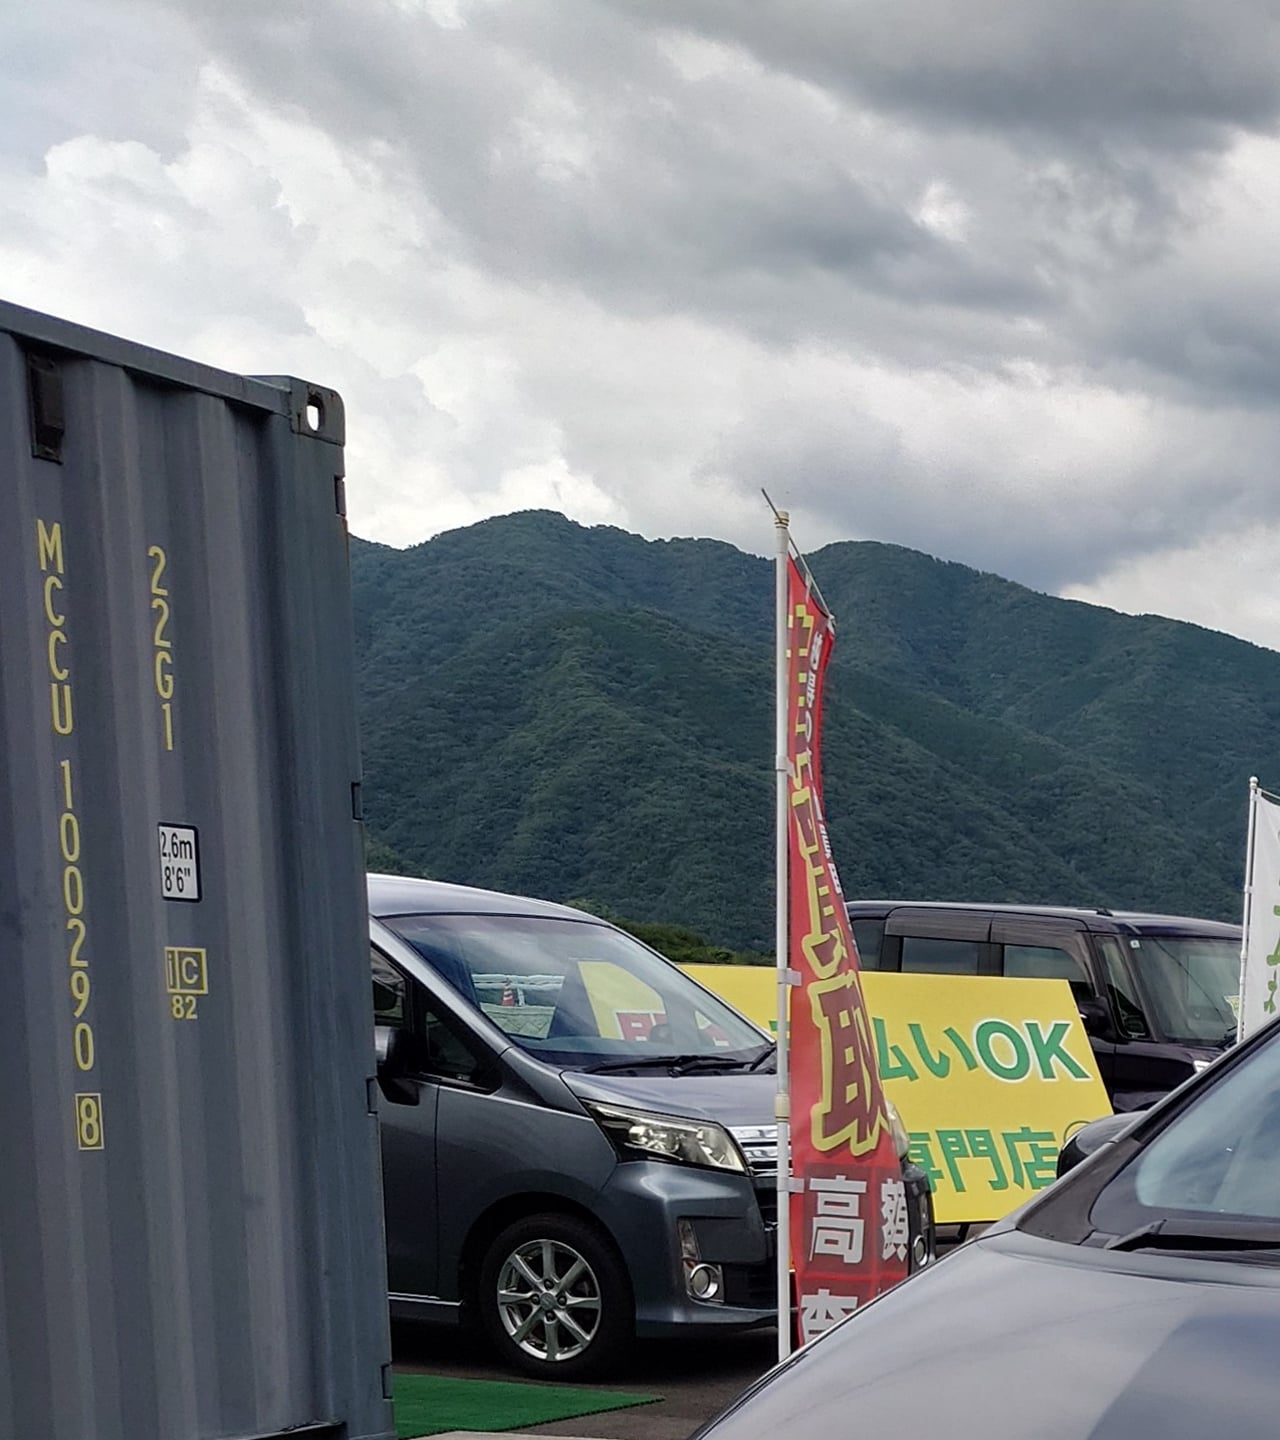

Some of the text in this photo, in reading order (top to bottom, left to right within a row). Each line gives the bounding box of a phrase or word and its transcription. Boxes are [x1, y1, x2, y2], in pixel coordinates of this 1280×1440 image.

[148, 545, 174, 750] 22G1
[37, 518, 73, 735] MCCU
[60, 759, 95, 1071] 100290
[172, 995, 198, 1020] 82
